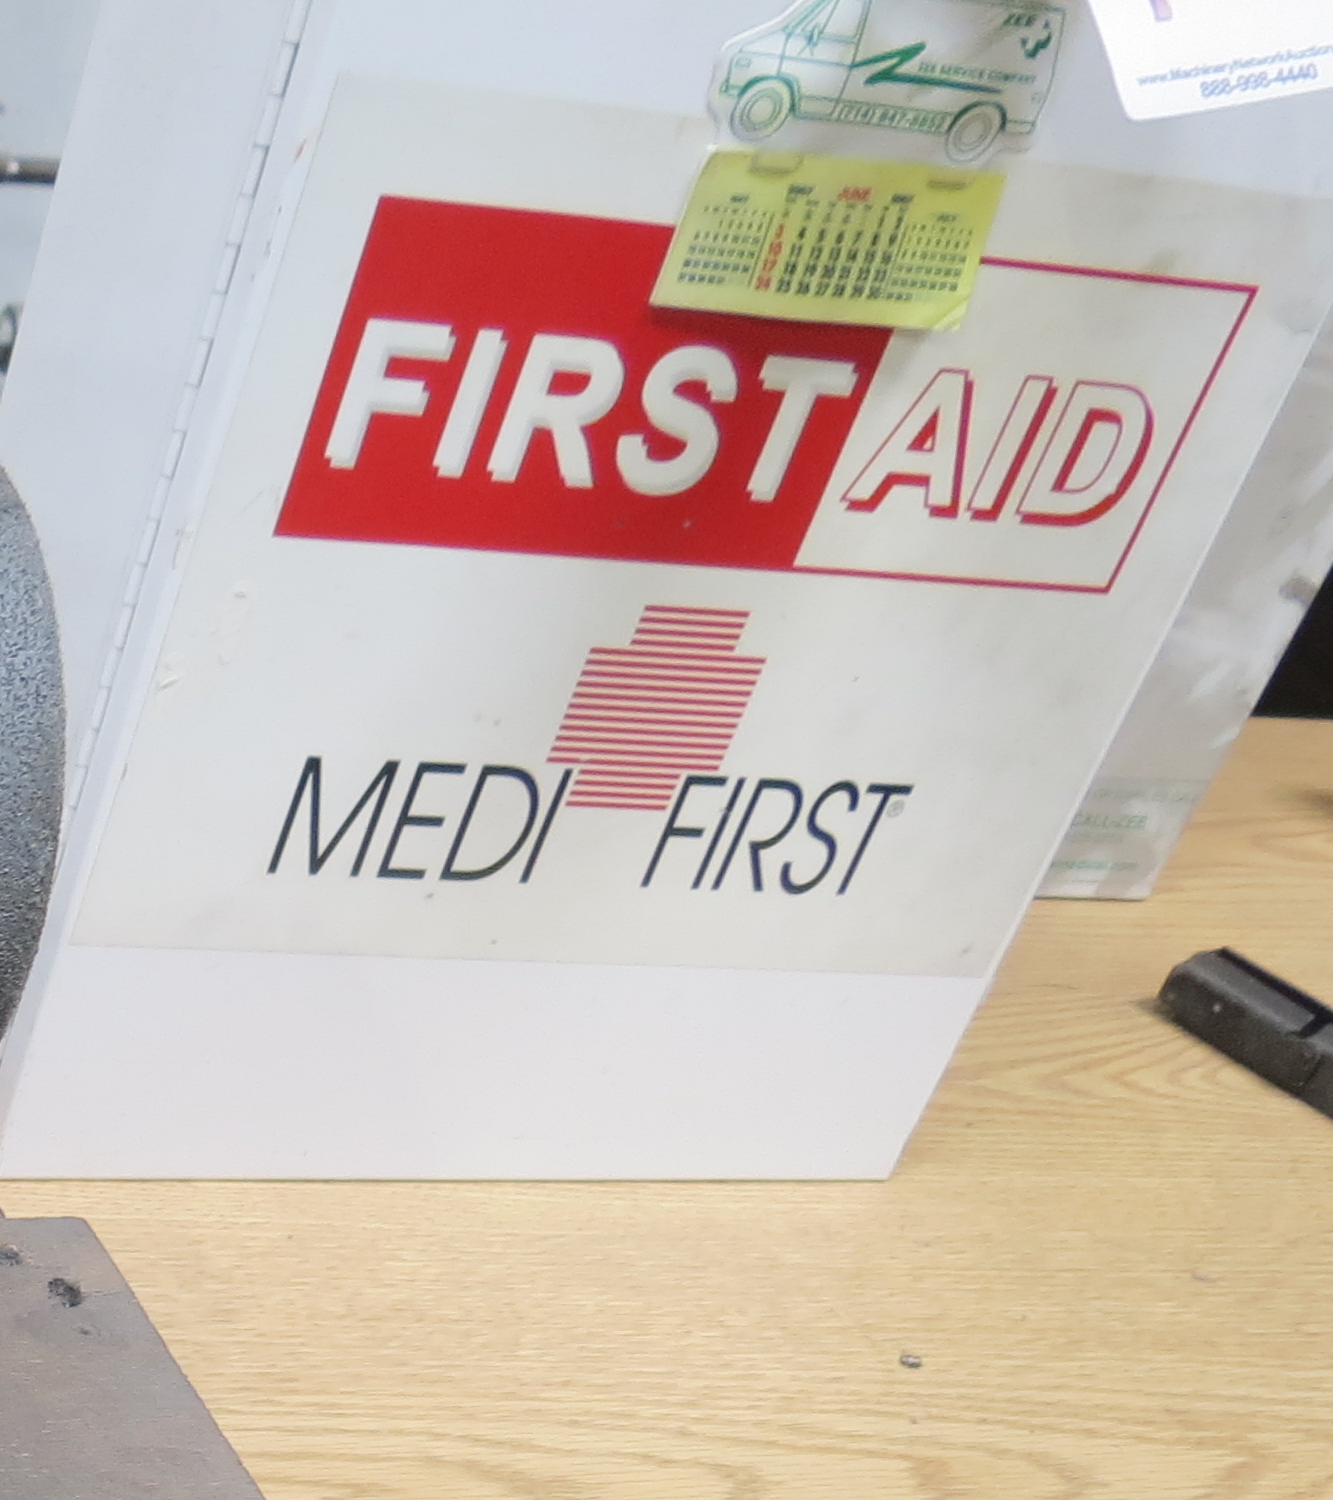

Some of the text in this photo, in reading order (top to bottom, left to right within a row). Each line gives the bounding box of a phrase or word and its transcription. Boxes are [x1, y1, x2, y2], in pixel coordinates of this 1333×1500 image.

[324, 316, 1154, 529] FIRST AID
[268, 755, 915, 896] MEDI FIRST
